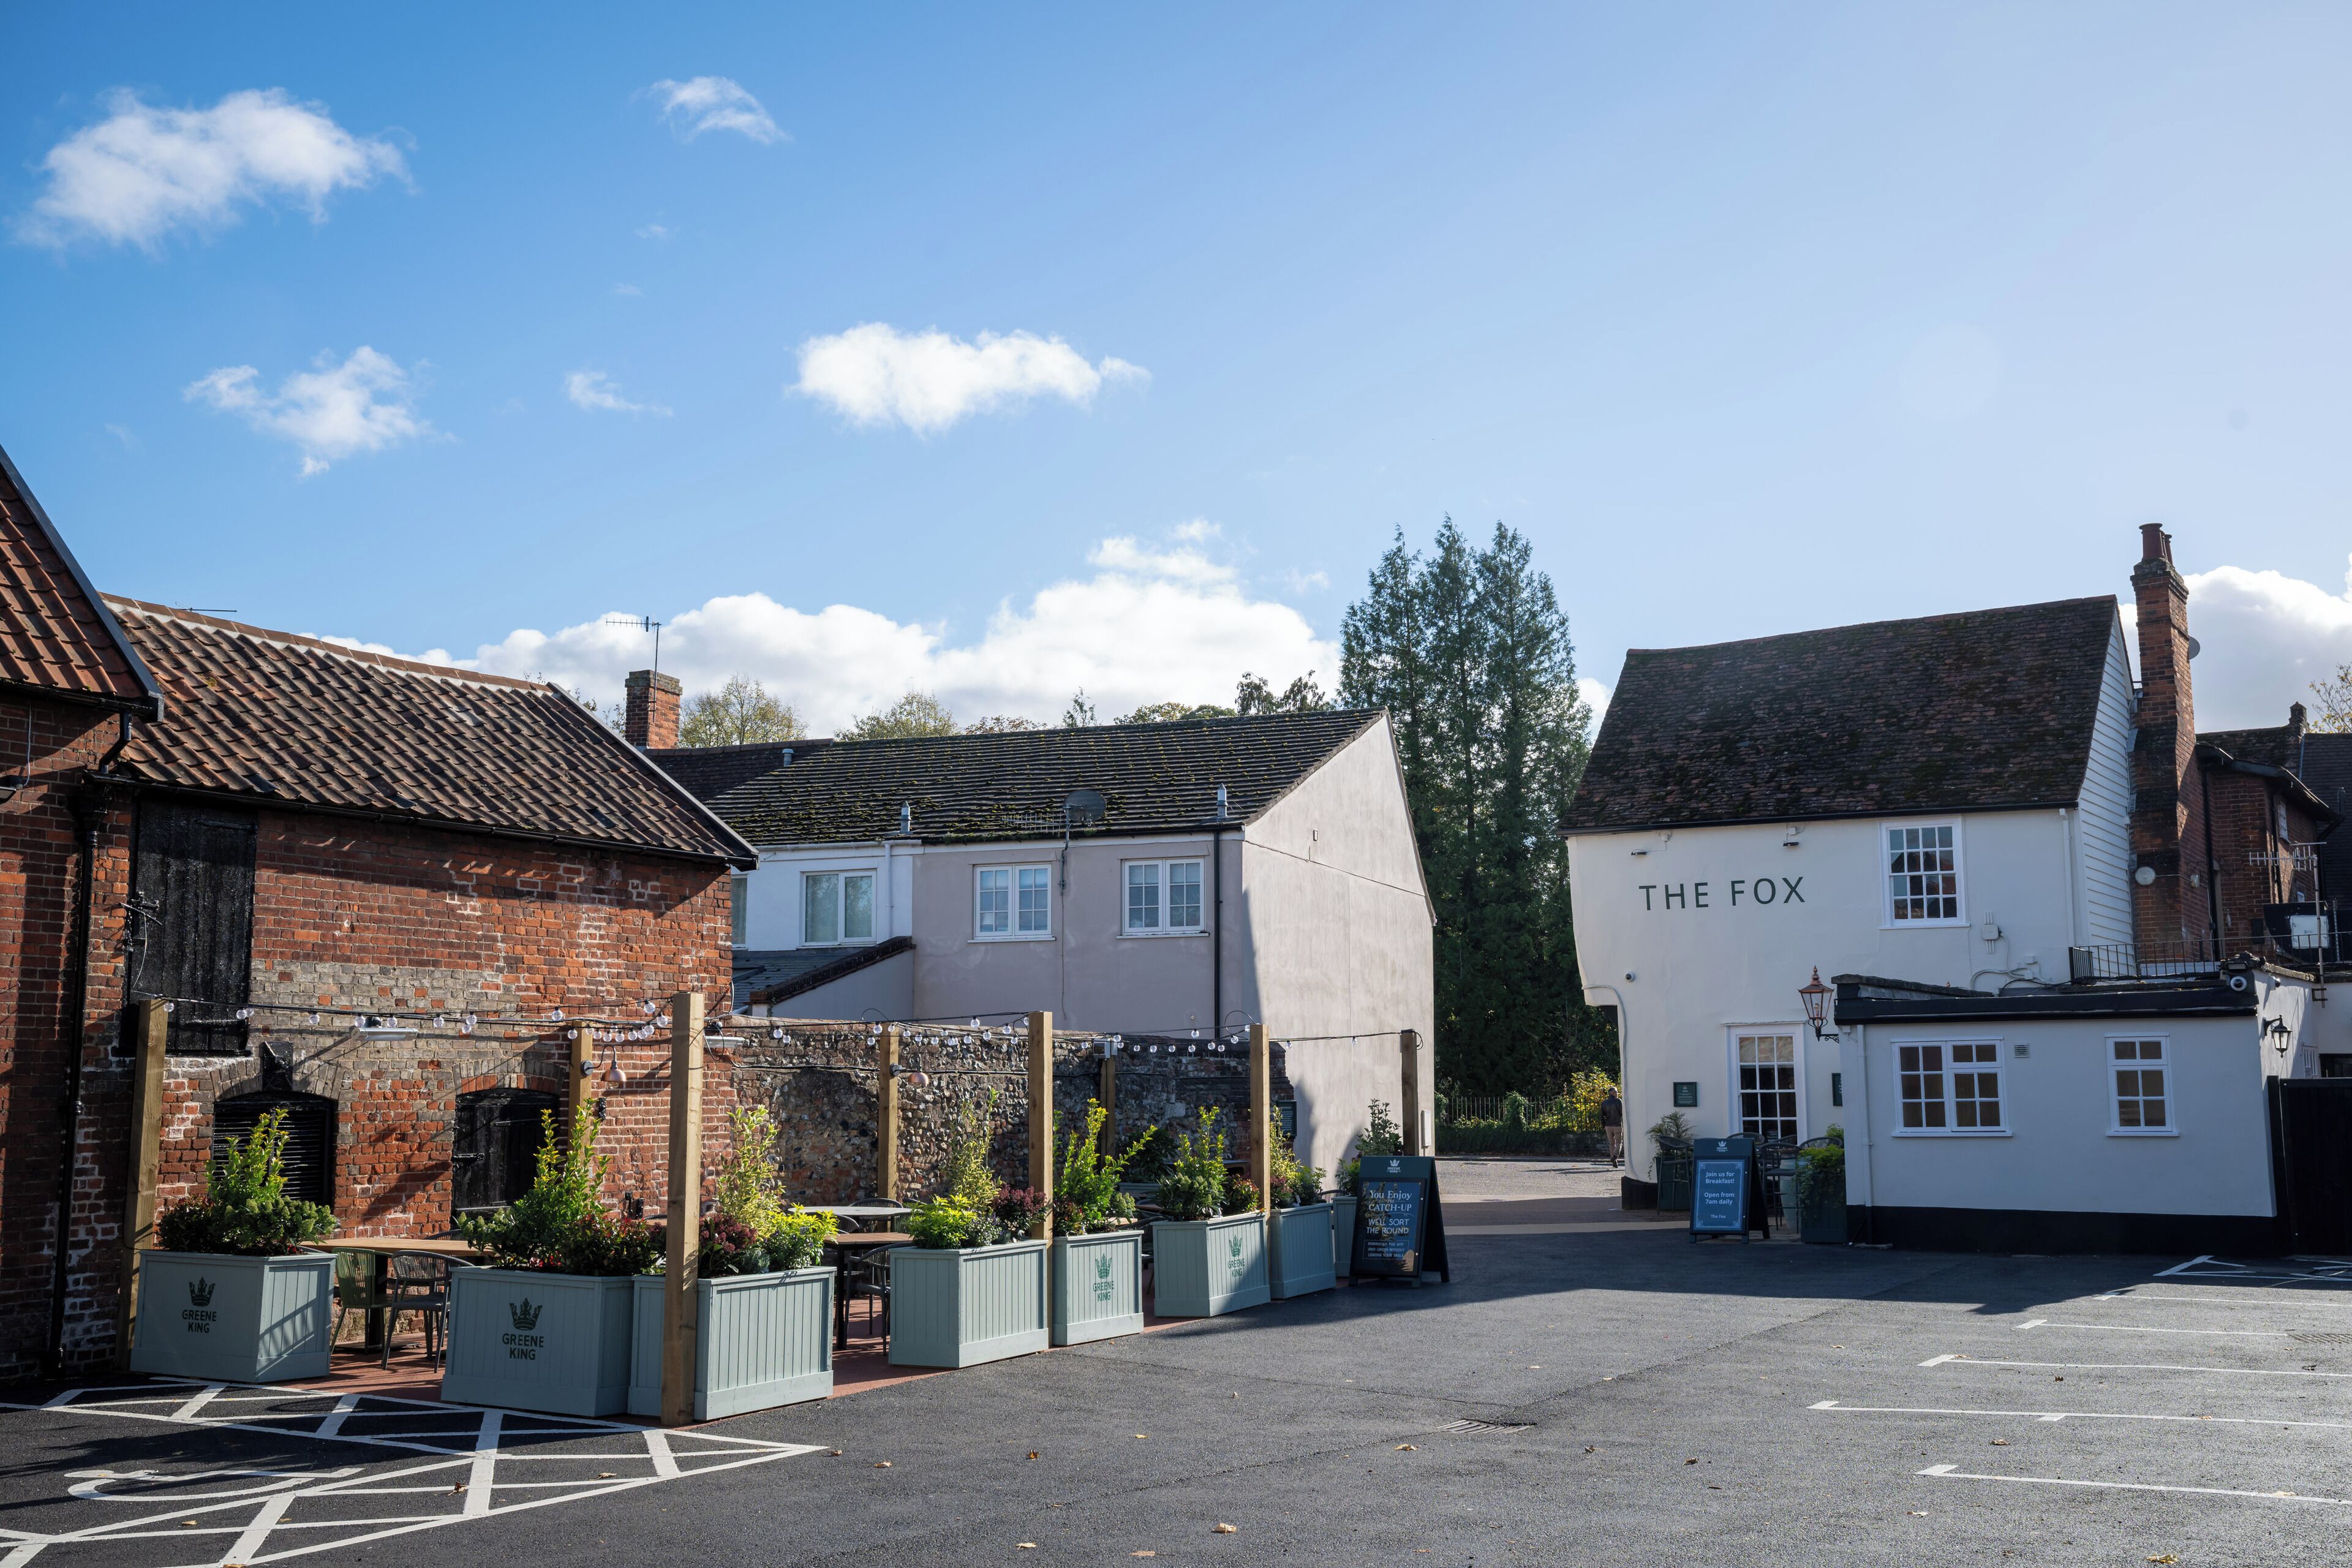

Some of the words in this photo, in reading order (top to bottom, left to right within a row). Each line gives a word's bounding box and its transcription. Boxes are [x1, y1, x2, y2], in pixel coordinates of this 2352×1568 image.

[1638, 882, 1709, 911] THE
[1731, 876, 1806, 907] FOX
[1370, 1190, 1384, 1199] You
[1387, 1190, 1412, 1200] Enjoy
[1227, 1257, 1245, 1268] GREENE
[1231, 1268, 1242, 1278] KING
[1093, 1280, 1114, 1292] GREENE
[1097, 1291, 1111, 1302] KING
[182, 1309, 217, 1322] GREENE
[188, 1322, 209, 1333] KING
[502, 1333, 544, 1348] GREENE
[510, 1348, 536, 1360] KING
